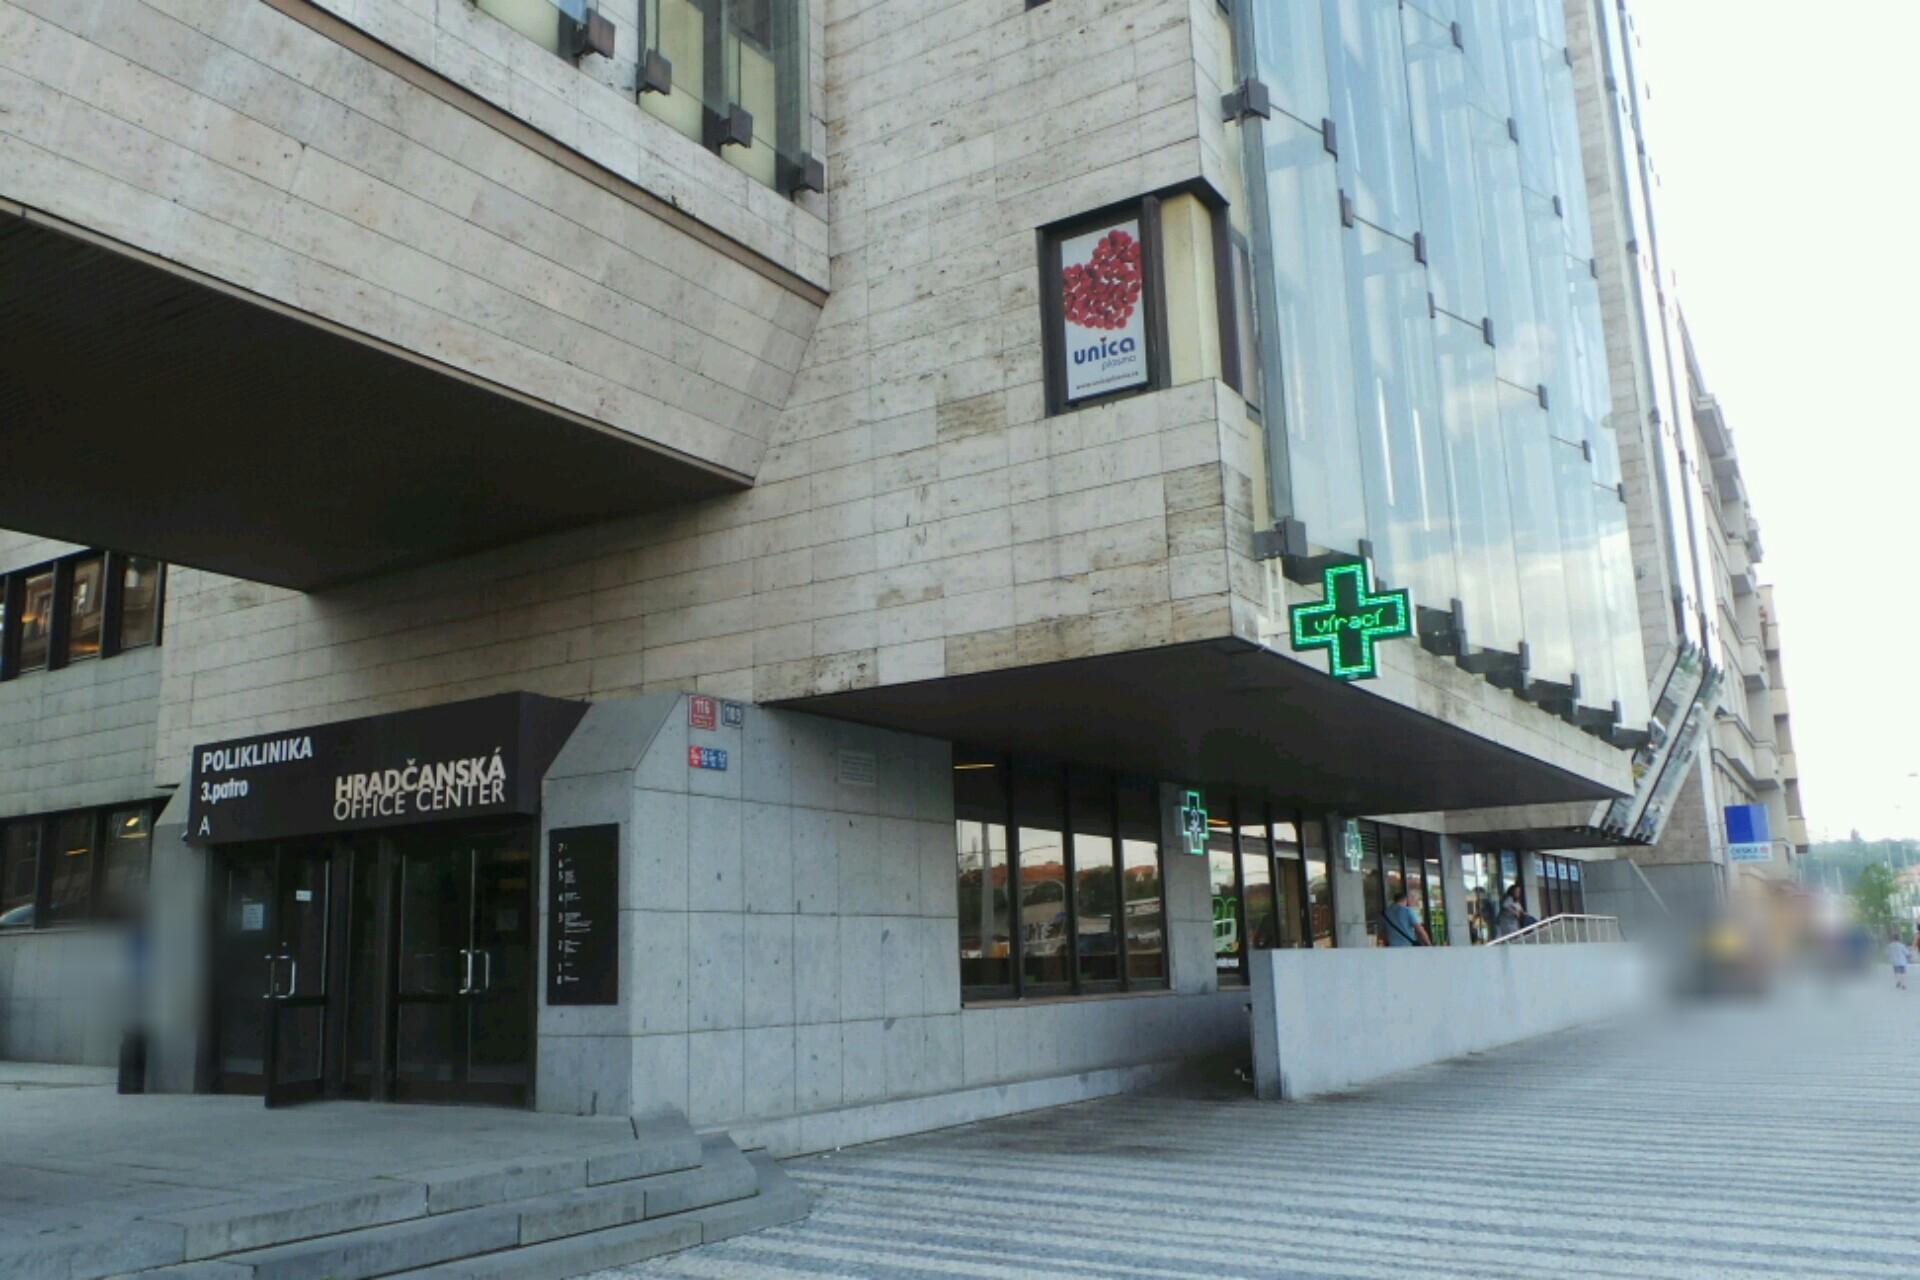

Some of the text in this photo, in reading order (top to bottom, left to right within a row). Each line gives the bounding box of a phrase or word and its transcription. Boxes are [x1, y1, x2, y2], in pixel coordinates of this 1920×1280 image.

[1074, 336, 1135, 365] unica
[201, 736, 313, 773] POLIKLINIKA
[335, 746, 506, 801] HRADČANSKÁ
[333, 779, 506, 821] OFFICE CENTER
[198, 816, 211, 836] A
